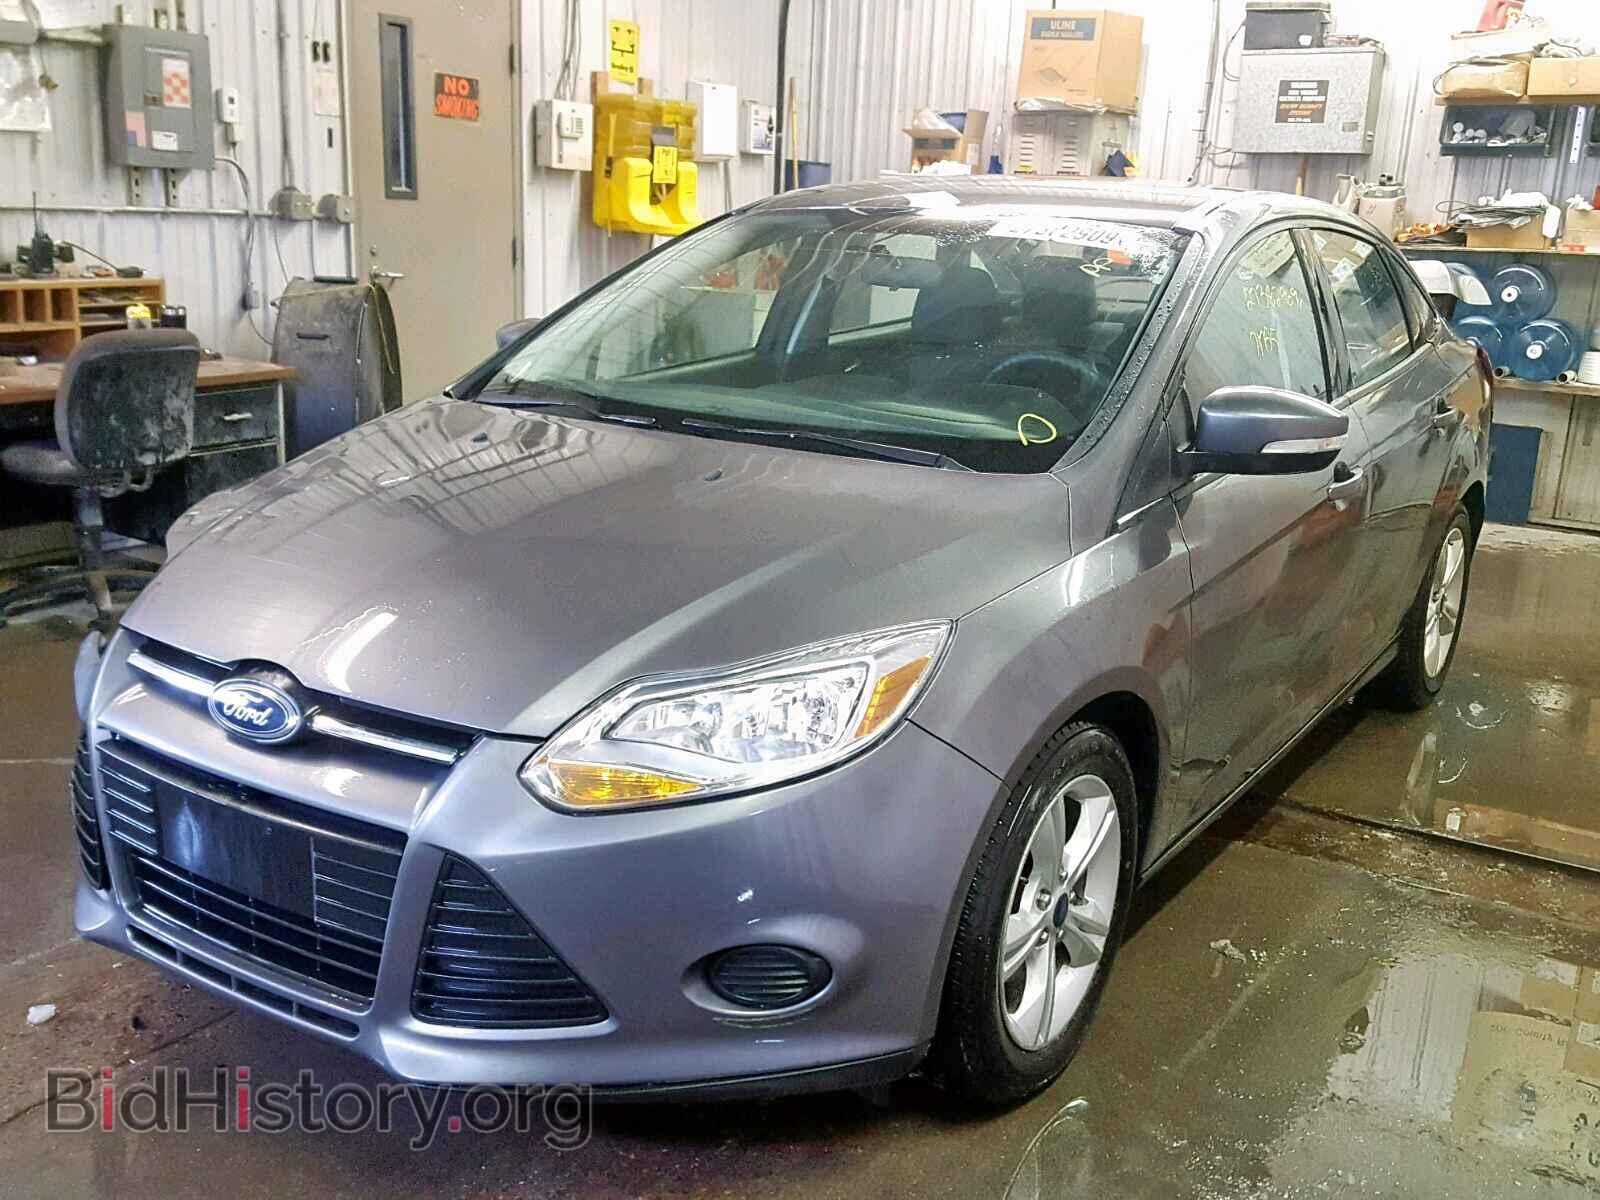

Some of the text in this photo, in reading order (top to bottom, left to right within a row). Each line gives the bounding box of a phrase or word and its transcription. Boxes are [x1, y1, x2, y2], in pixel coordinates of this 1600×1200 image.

[1050, 19, 1077, 31] ULINE
[444, 76, 470, 97] NO
[222, 690, 273, 726] Ford
